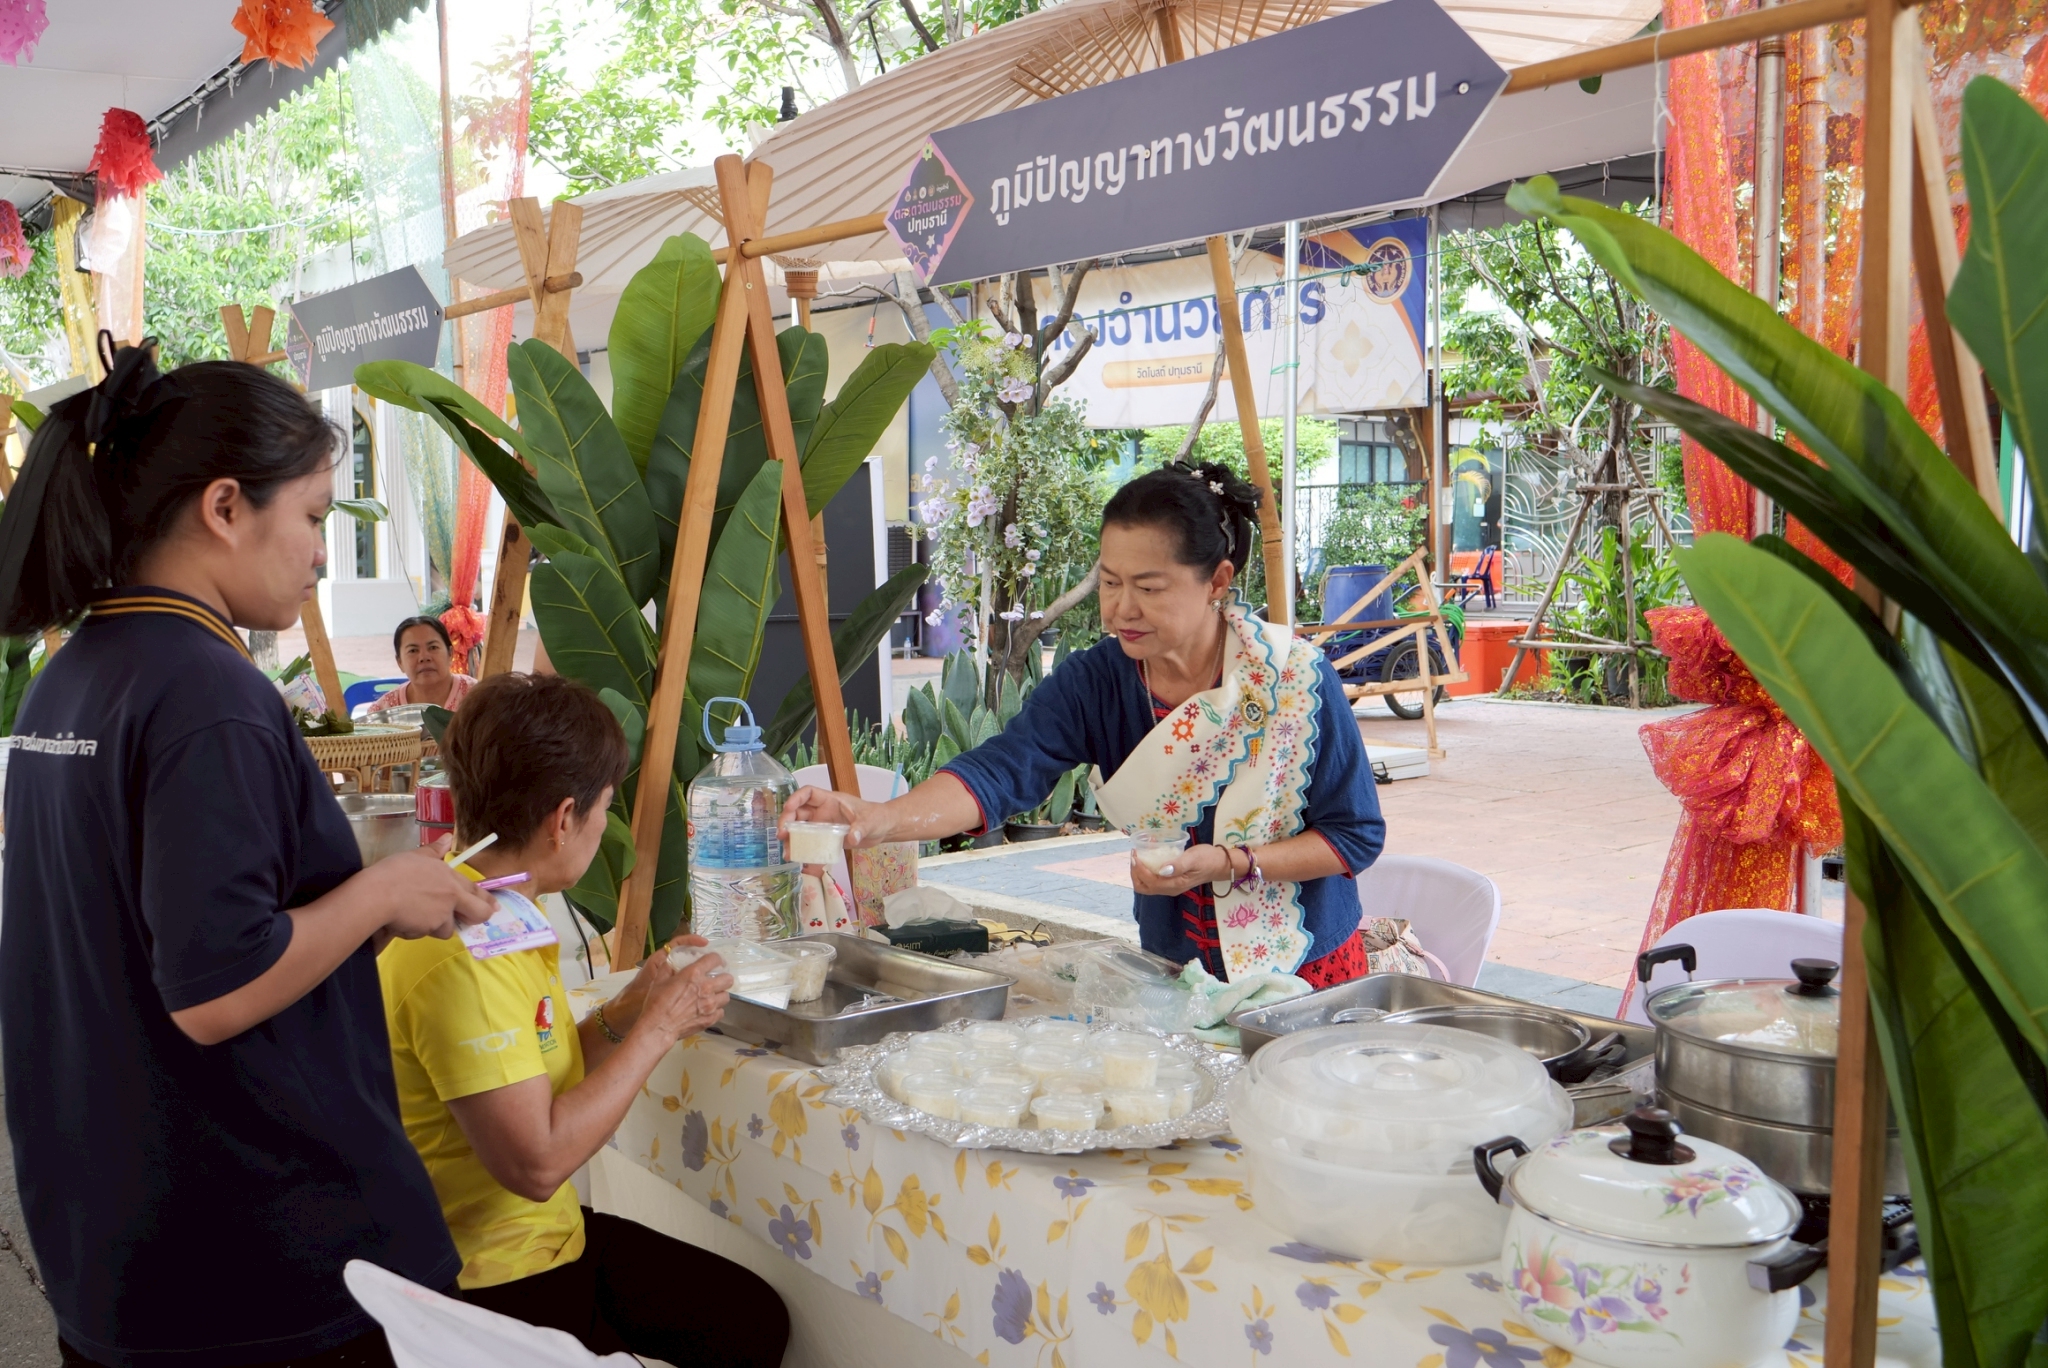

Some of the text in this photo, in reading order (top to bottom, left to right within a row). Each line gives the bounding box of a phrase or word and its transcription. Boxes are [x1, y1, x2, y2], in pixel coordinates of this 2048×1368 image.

[990, 71, 1436, 226] ภูมิปัญญาทางวัฒนธรรม
[894, 194, 962, 221] ตลาดวัฒนธรรม
[907, 209, 948, 236] ปทุมธานี
[1040, 281, 1326, 351] องอำนวกร
[316, 305, 429, 363] ภูมิปัญญาทางวัฒนธรรม
[1137, 362, 1203, 379] วัดโบสถ์ ปทุมธานี
[458, 1027, 522, 1056] TOT
